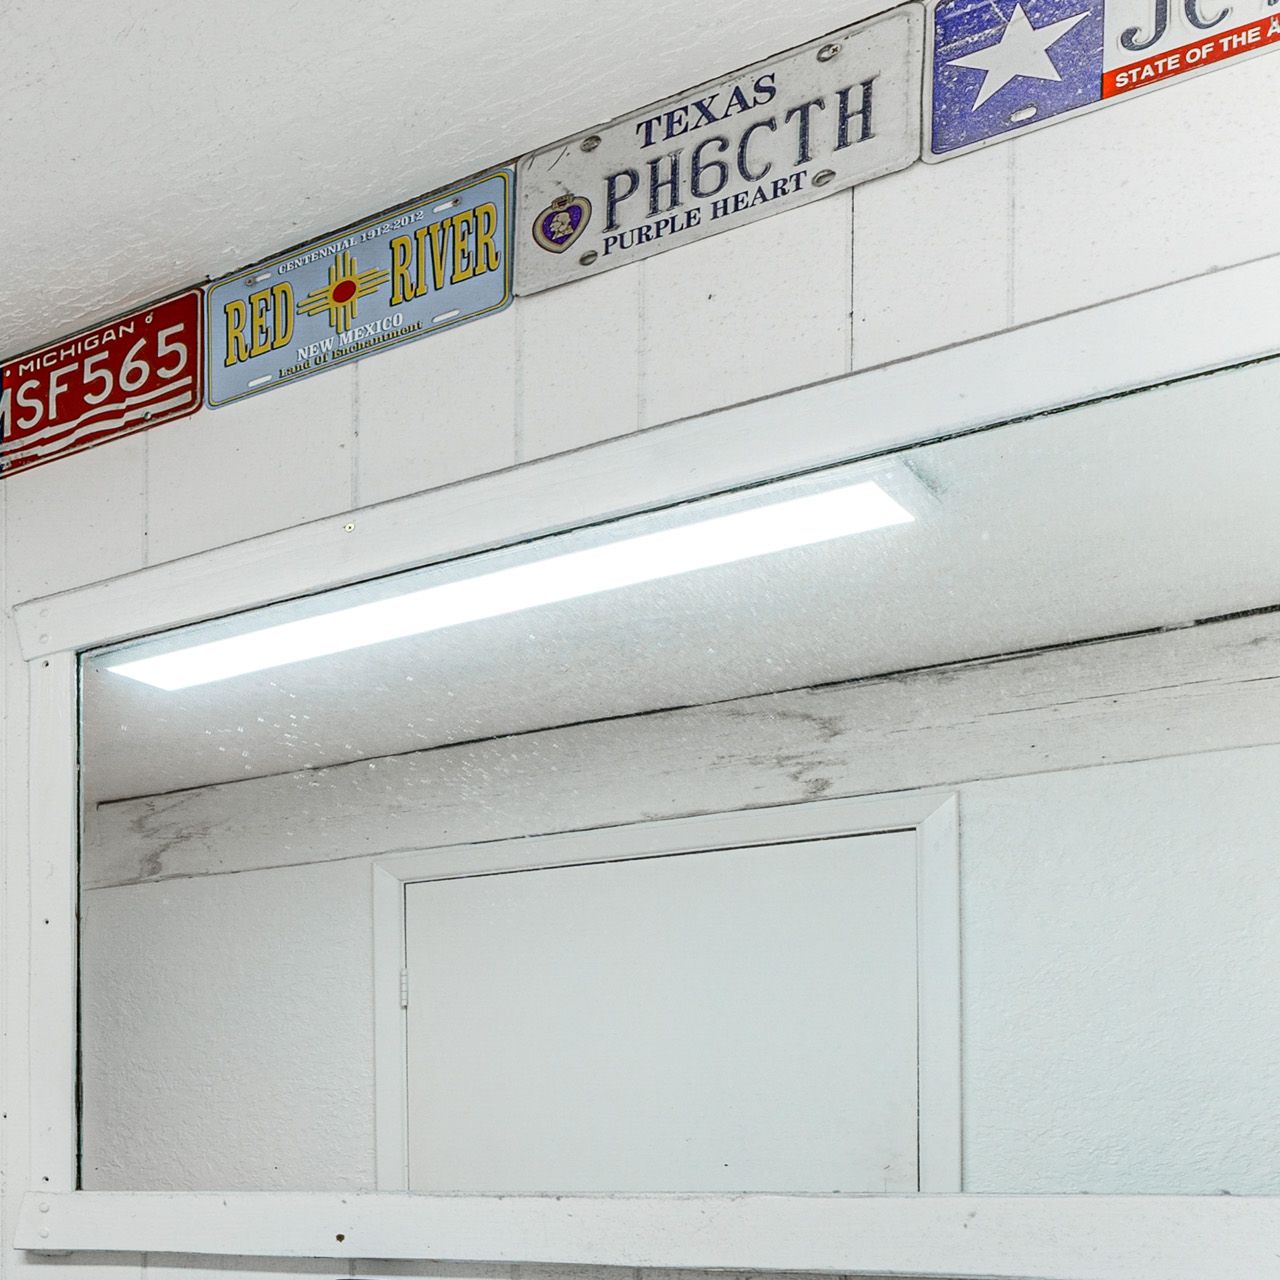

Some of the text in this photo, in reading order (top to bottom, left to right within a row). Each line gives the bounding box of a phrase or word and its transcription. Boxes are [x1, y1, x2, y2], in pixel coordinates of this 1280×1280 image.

[1115, 53, 1180, 88] STATE
[1185, 42, 1215, 64] OF
[1218, 26, 1262, 52] THE
[636, 72, 777, 150] TEXAS
[602, 73, 877, 233] PH6CTH
[277, 211, 424, 275] CENTENNIAL 1912-2012
[602, 170, 808, 256] PURPLE HEART
[224, 202, 501, 367] RED RIVER
[18, 321, 134, 377] MICHIGAN
[297, 312, 404, 362] NEW MEXICO
